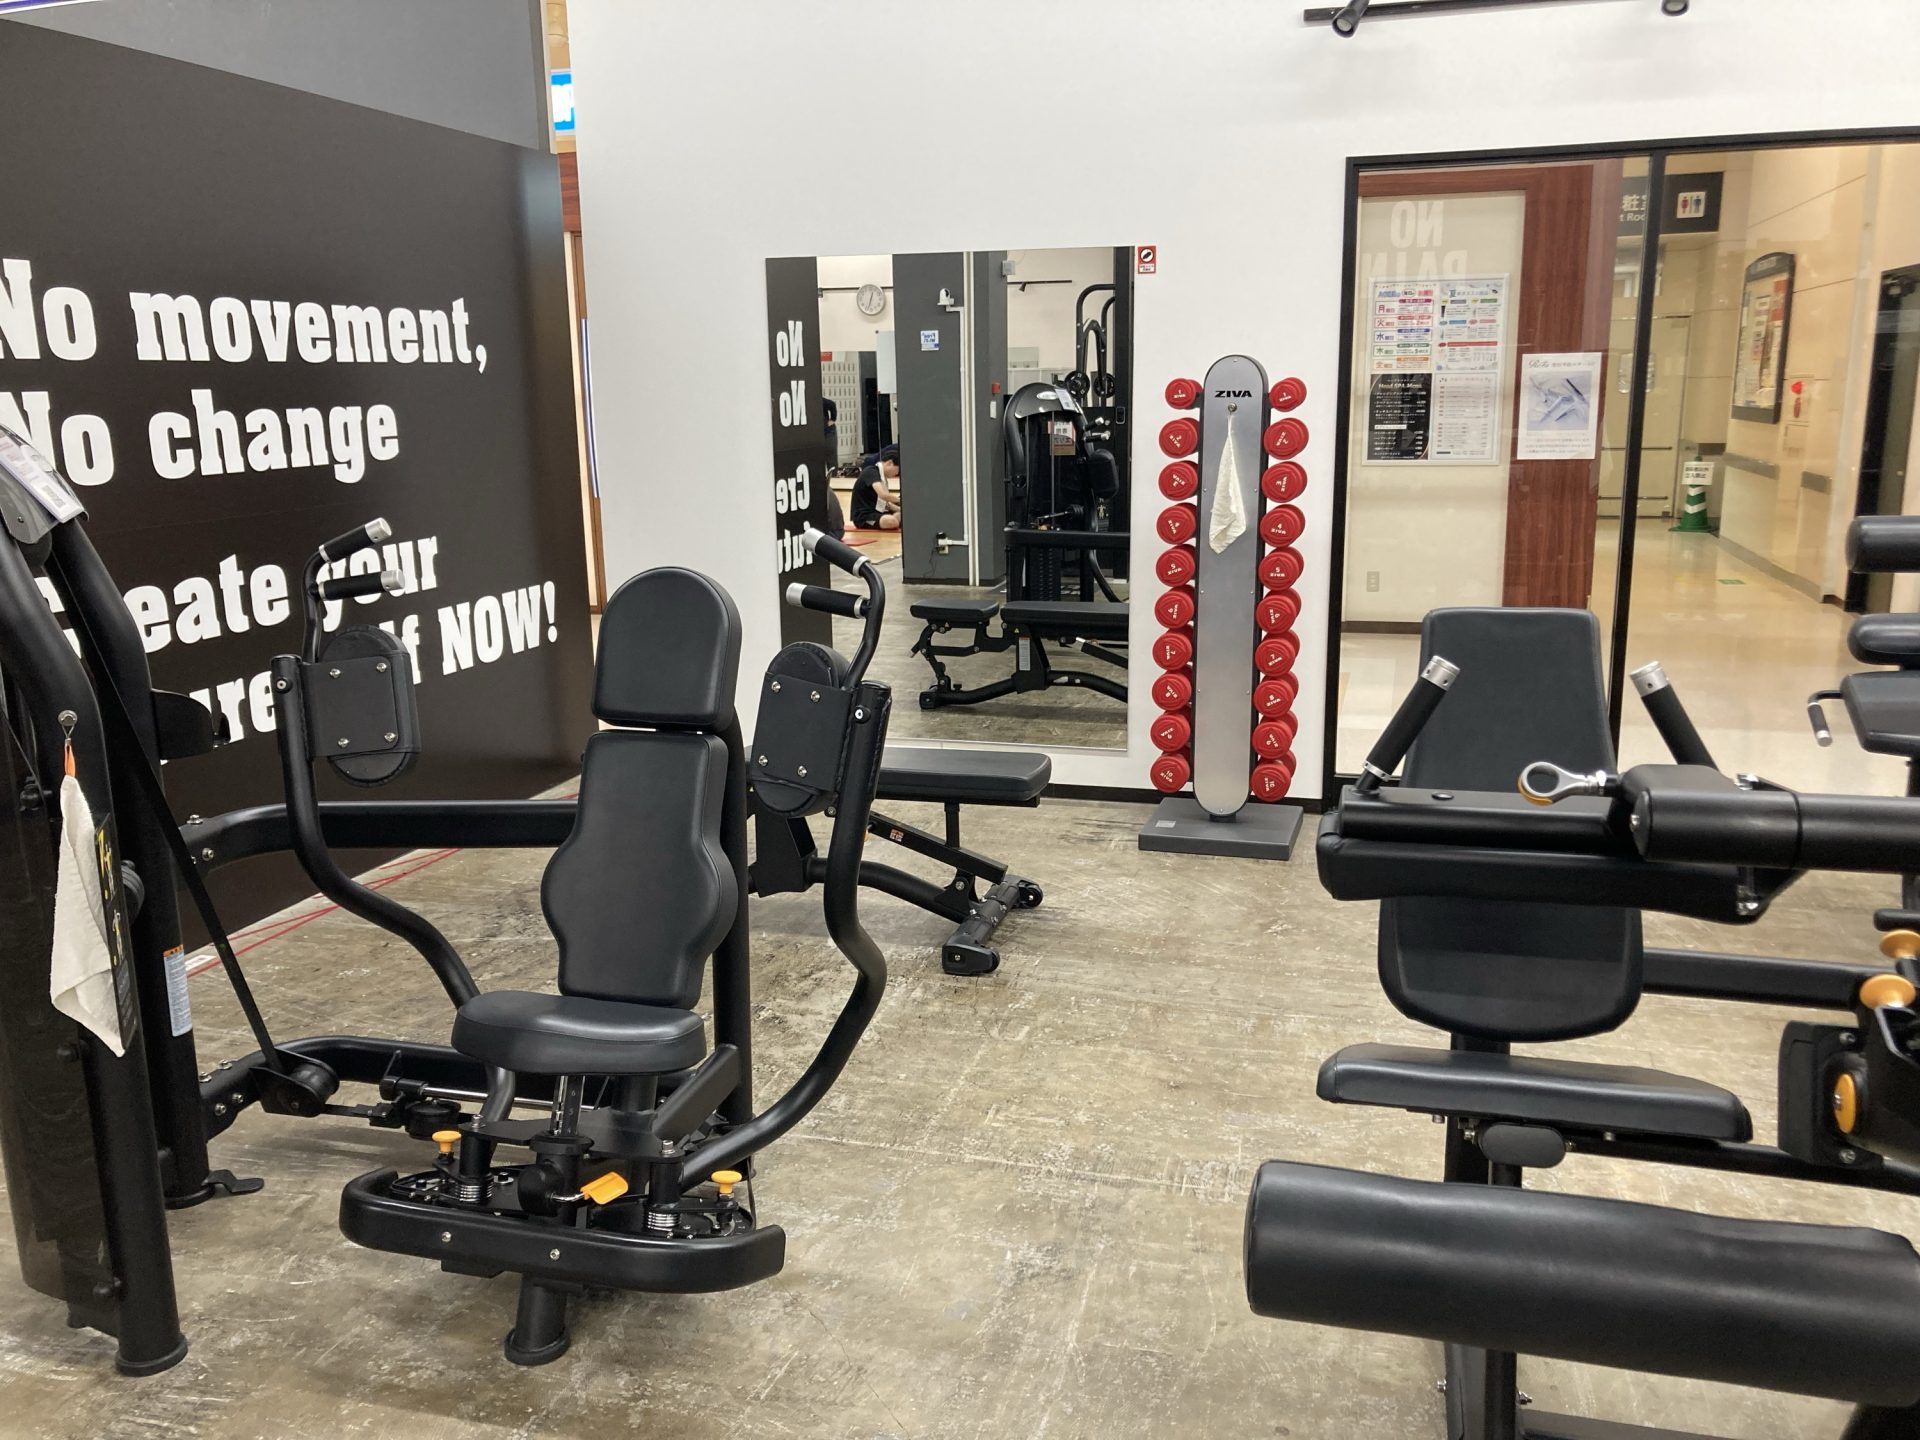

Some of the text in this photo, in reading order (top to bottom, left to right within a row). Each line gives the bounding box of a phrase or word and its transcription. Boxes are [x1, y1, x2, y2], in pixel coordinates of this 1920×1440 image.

[129, 291, 488, 374] movement,
[149, 389, 399, 483] change
[1214, 390, 1253, 398] ZIVA
[437, 581, 558, 676] NOW!
